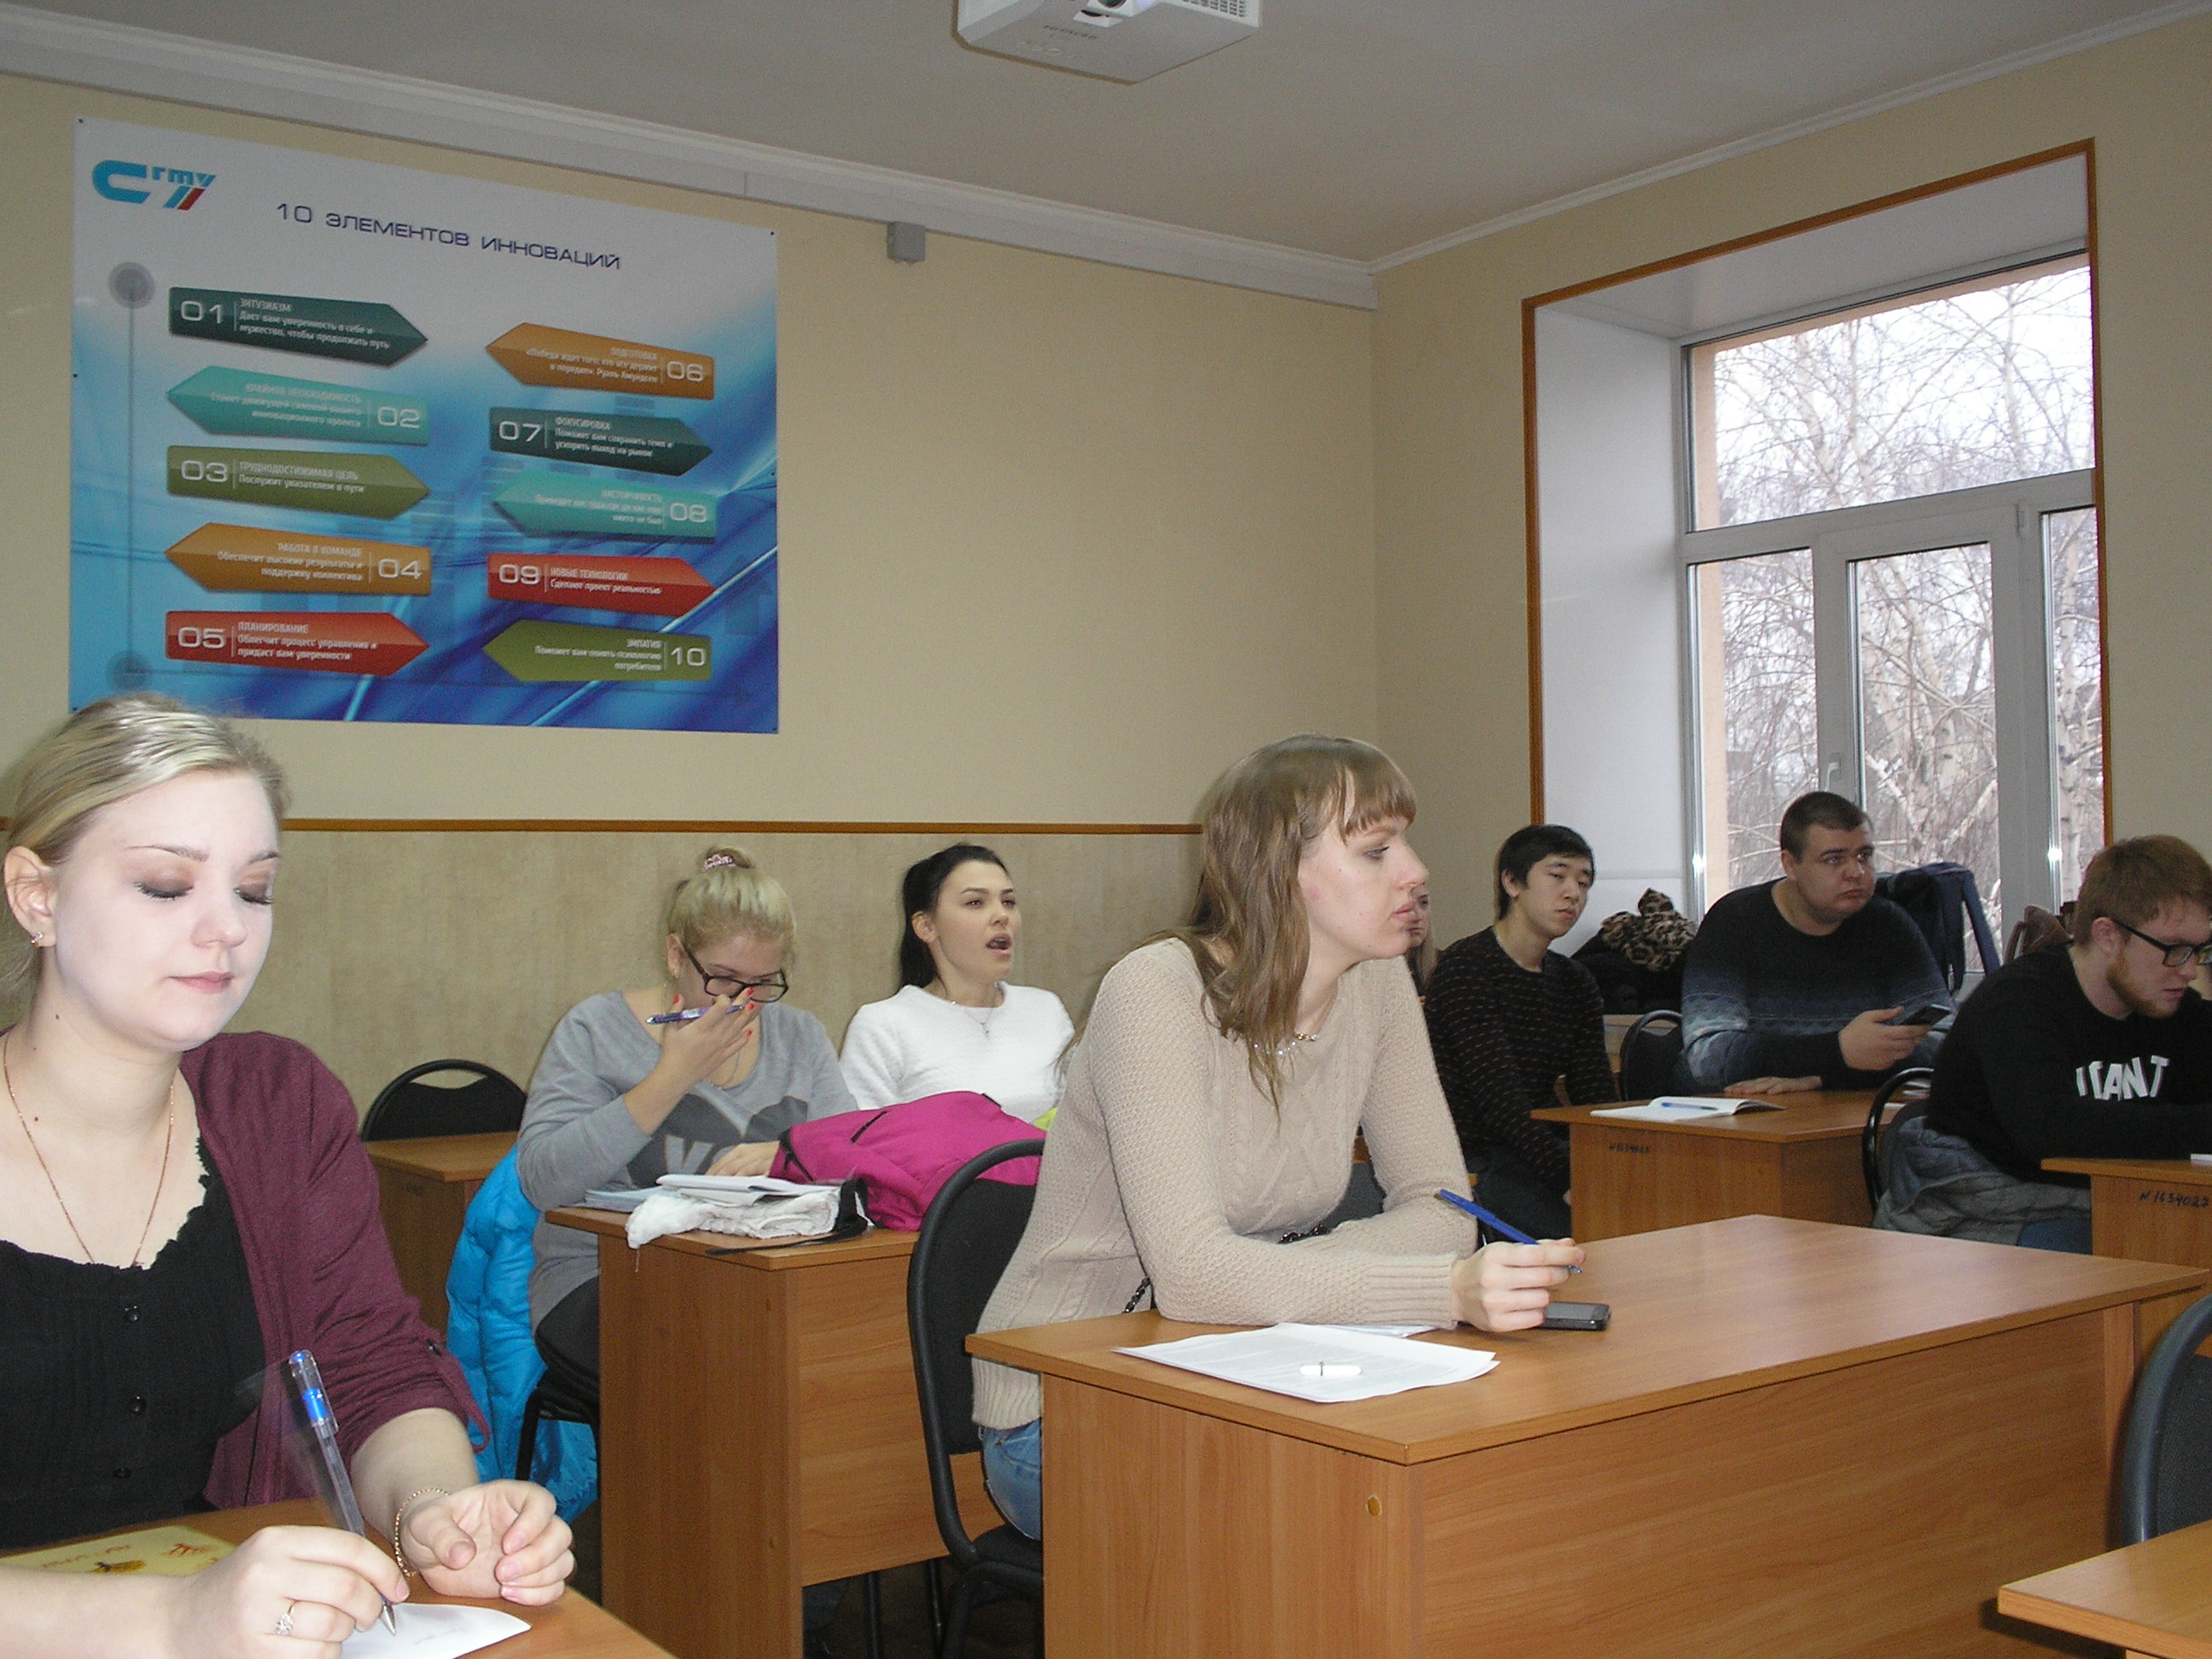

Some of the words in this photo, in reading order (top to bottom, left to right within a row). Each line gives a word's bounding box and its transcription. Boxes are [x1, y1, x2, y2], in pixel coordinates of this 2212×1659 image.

[276, 202, 312, 224] 10
[326, 212, 469, 247] ЭЛЕМЕНТОВ
[480, 236, 620, 270] ИННОВАЦИЙ
[180, 300, 224, 323] 01
[667, 361, 704, 381] 06
[377, 406, 421, 428] 02
[498, 421, 542, 442] 07
[180, 460, 228, 483] 03
[669, 503, 707, 523] 08
[377, 558, 423, 580] 04
[498, 563, 541, 585] 09
[178, 626, 227, 649] 05
[671, 647, 707, 667] 10
